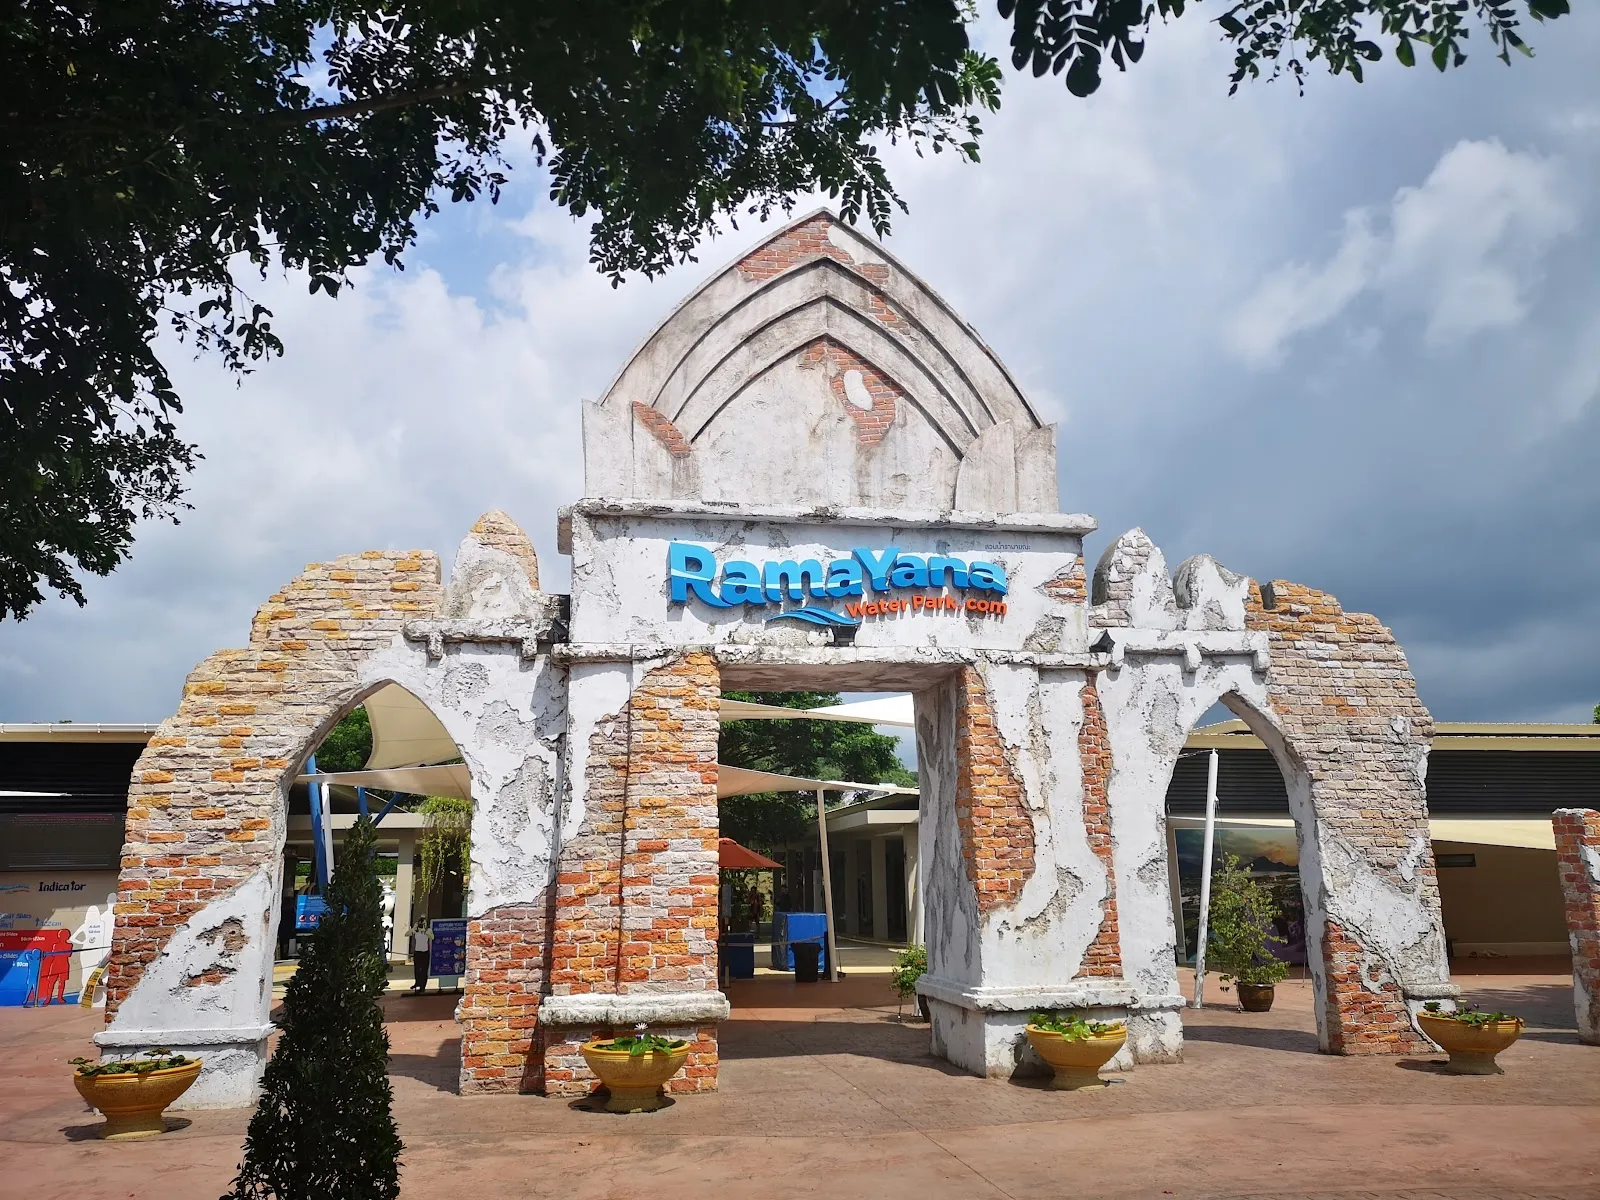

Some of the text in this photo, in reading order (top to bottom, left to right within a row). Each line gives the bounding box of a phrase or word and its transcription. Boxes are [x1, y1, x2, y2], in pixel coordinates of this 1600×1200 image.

[668, 541, 1008, 609] RamaYana
[844, 598, 909, 618] Water
[38, 880, 87, 892] Indicator
